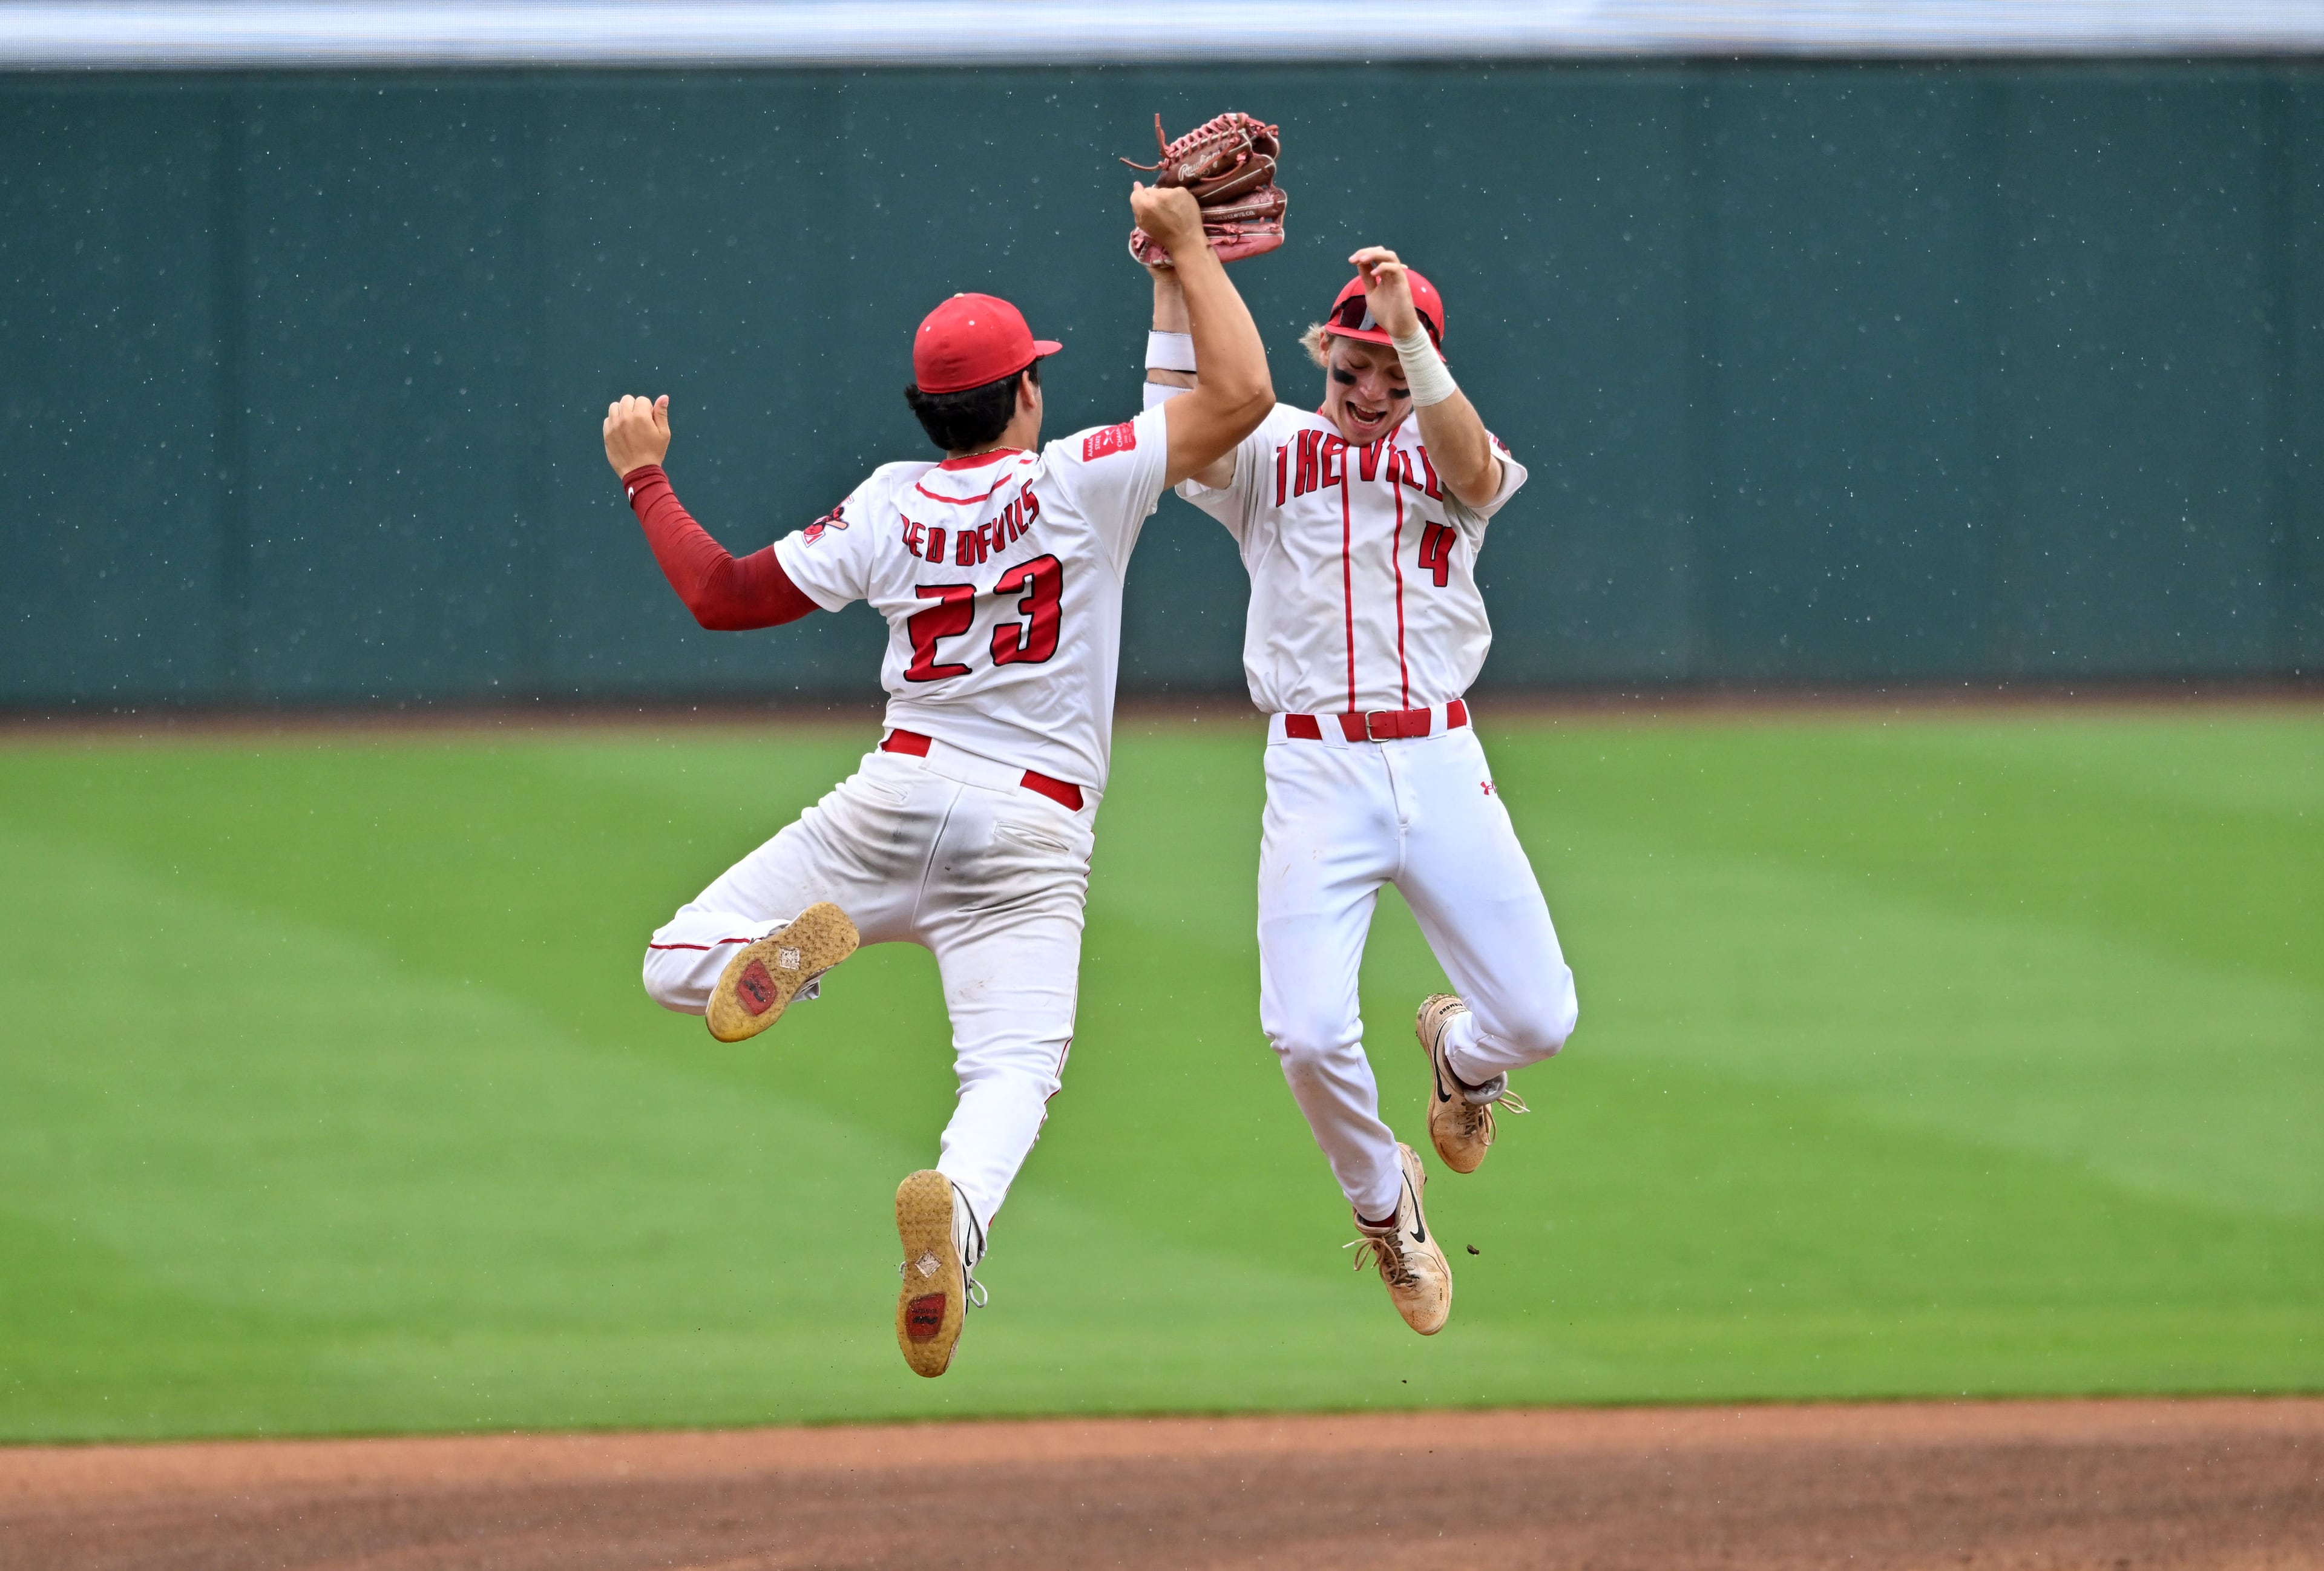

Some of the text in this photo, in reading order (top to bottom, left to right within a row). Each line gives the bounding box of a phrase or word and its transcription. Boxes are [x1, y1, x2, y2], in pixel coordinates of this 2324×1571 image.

[1178, 149, 1221, 181] Rawling
[1276, 429, 1443, 508] THE VILL
[1418, 520, 1457, 587] 4
[903, 553, 1063, 683] 23
